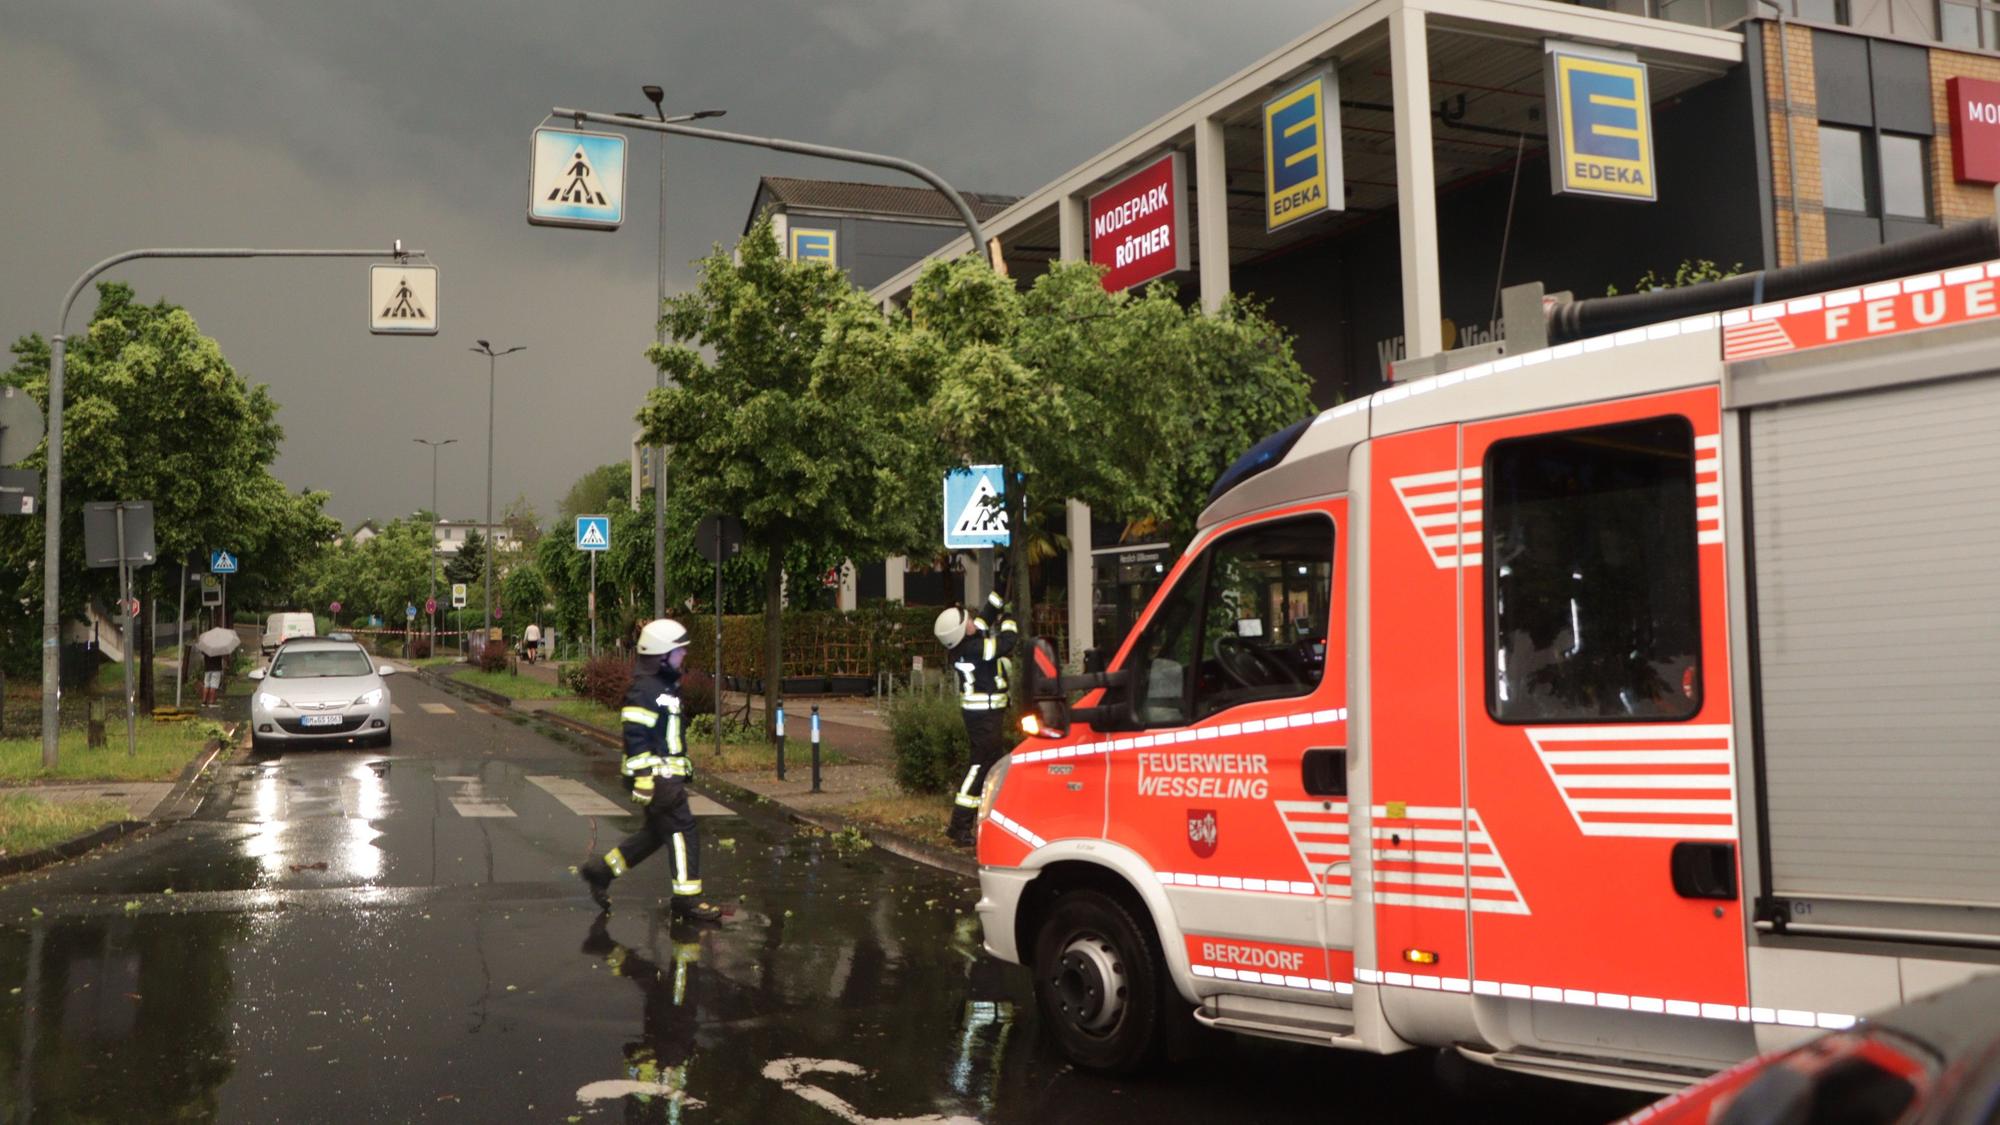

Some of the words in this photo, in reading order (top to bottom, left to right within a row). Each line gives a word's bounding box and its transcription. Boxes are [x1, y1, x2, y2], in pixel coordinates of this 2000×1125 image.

[1568, 68, 1641, 162] E
[1968, 100, 2000, 125] MO
[1271, 94, 1319, 193] E
[1574, 162, 1645, 185] EDEKA
[1095, 182, 1169, 239] MODEPARK
[1273, 184, 1321, 216] EDEKA
[1116, 224, 1170, 269] RÖTHER
[1824, 280, 1998, 341] FEUE
[1138, 753, 1269, 774] FEUERWEHR
[1138, 776, 1269, 799] WESSELING
[1794, 901, 1813, 914] G1
[1202, 942, 1304, 971] BERZDORF
